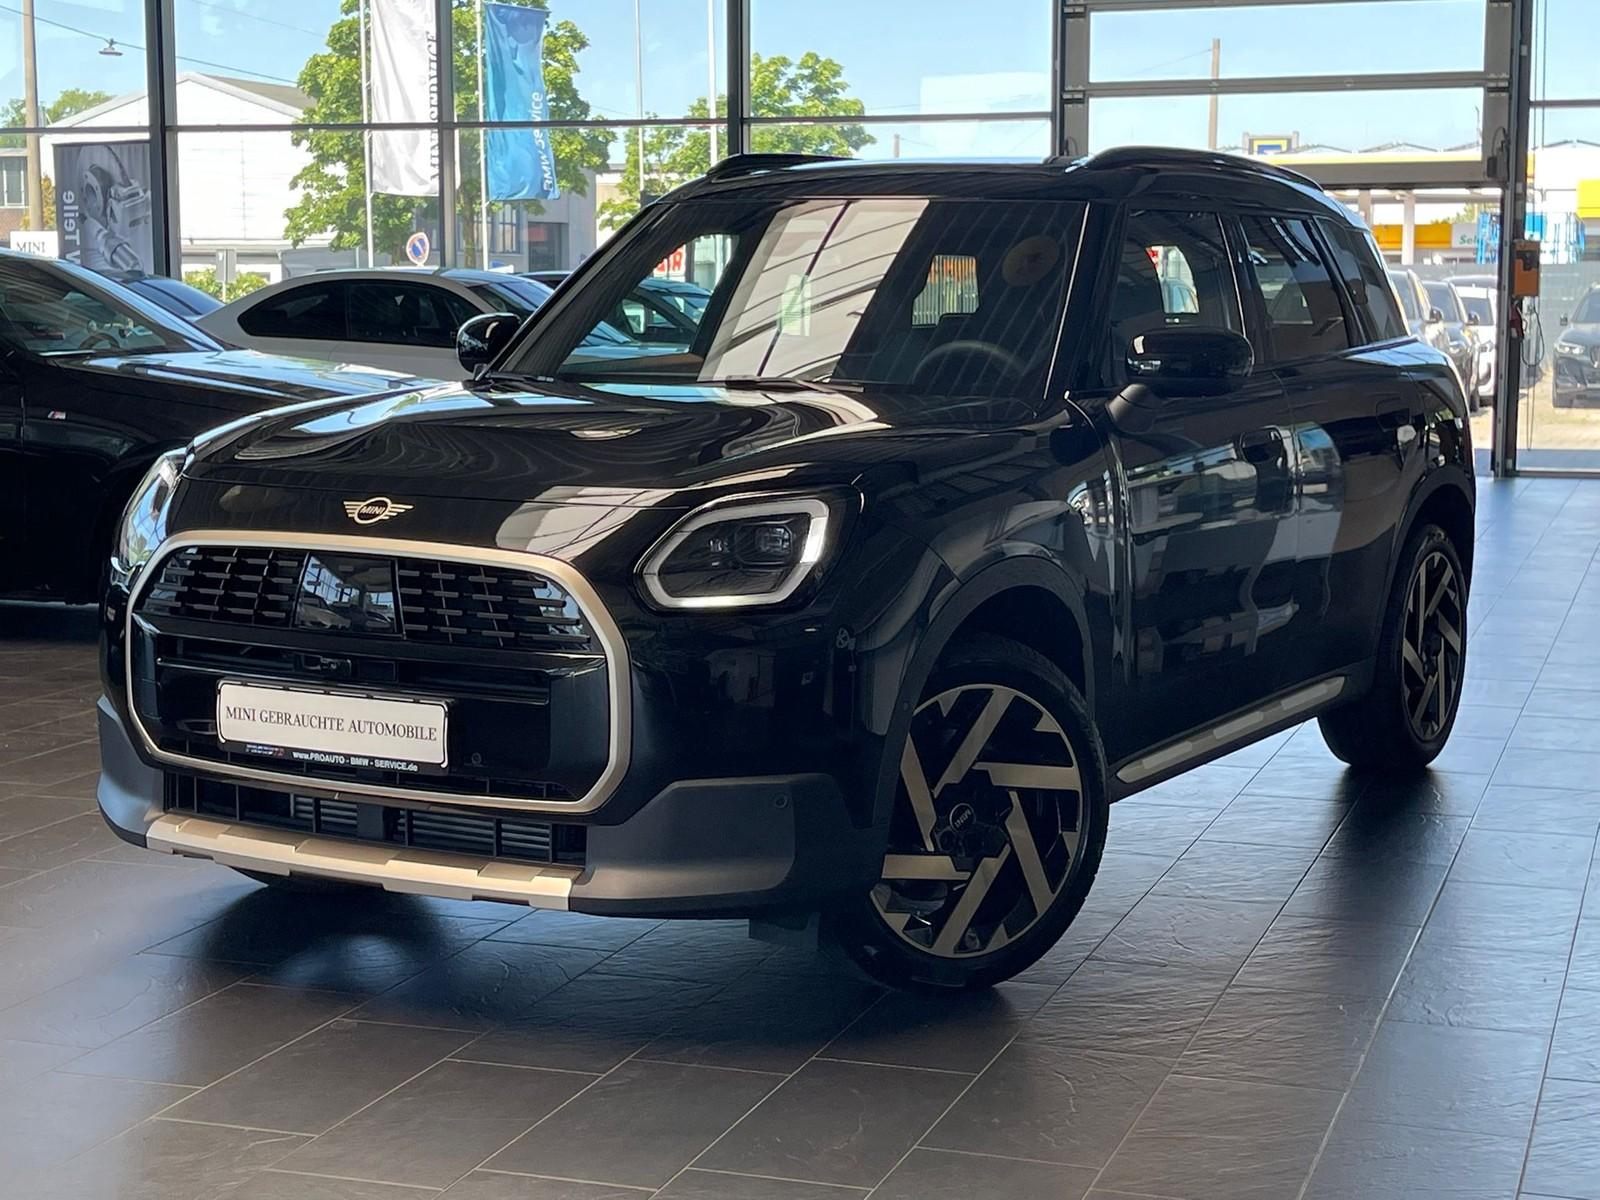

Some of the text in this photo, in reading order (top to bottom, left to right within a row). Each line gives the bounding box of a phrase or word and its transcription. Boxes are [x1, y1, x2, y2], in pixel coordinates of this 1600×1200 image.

[530, 91, 546, 149] Sevice
[16, 241, 46, 254] MINI
[359, 505, 386, 515] MINI
[226, 705, 437, 742] MINI GEBRAUCHTE AUTOMOBILE
